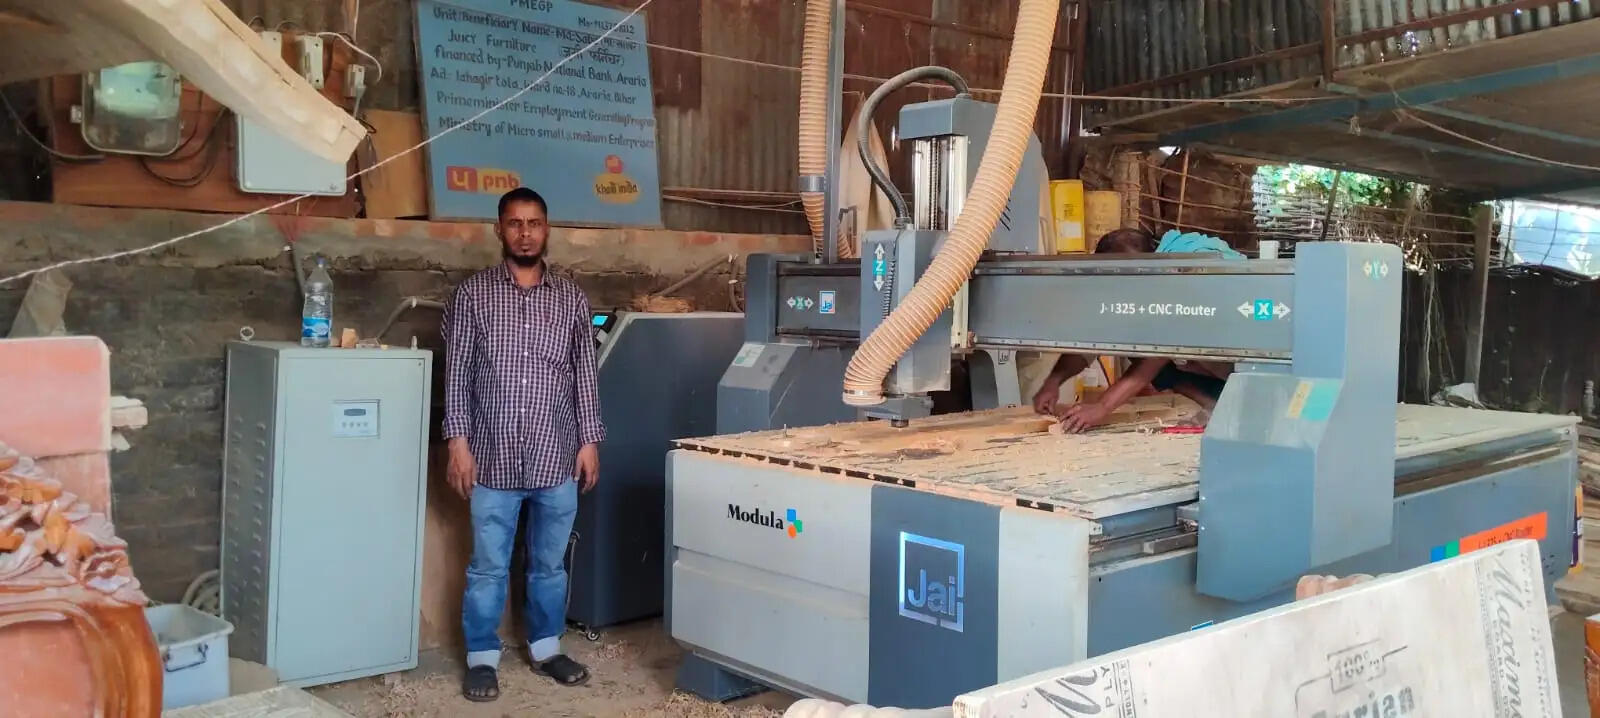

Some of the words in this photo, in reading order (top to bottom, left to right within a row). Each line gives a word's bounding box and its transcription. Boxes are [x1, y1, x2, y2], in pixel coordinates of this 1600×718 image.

[483, 174, 519, 192] pnb
[1148, 303, 1173, 315] CNC
[1175, 303, 1217, 317] Router
[727, 503, 784, 530] Modula
[908, 568, 956, 617] Jai
